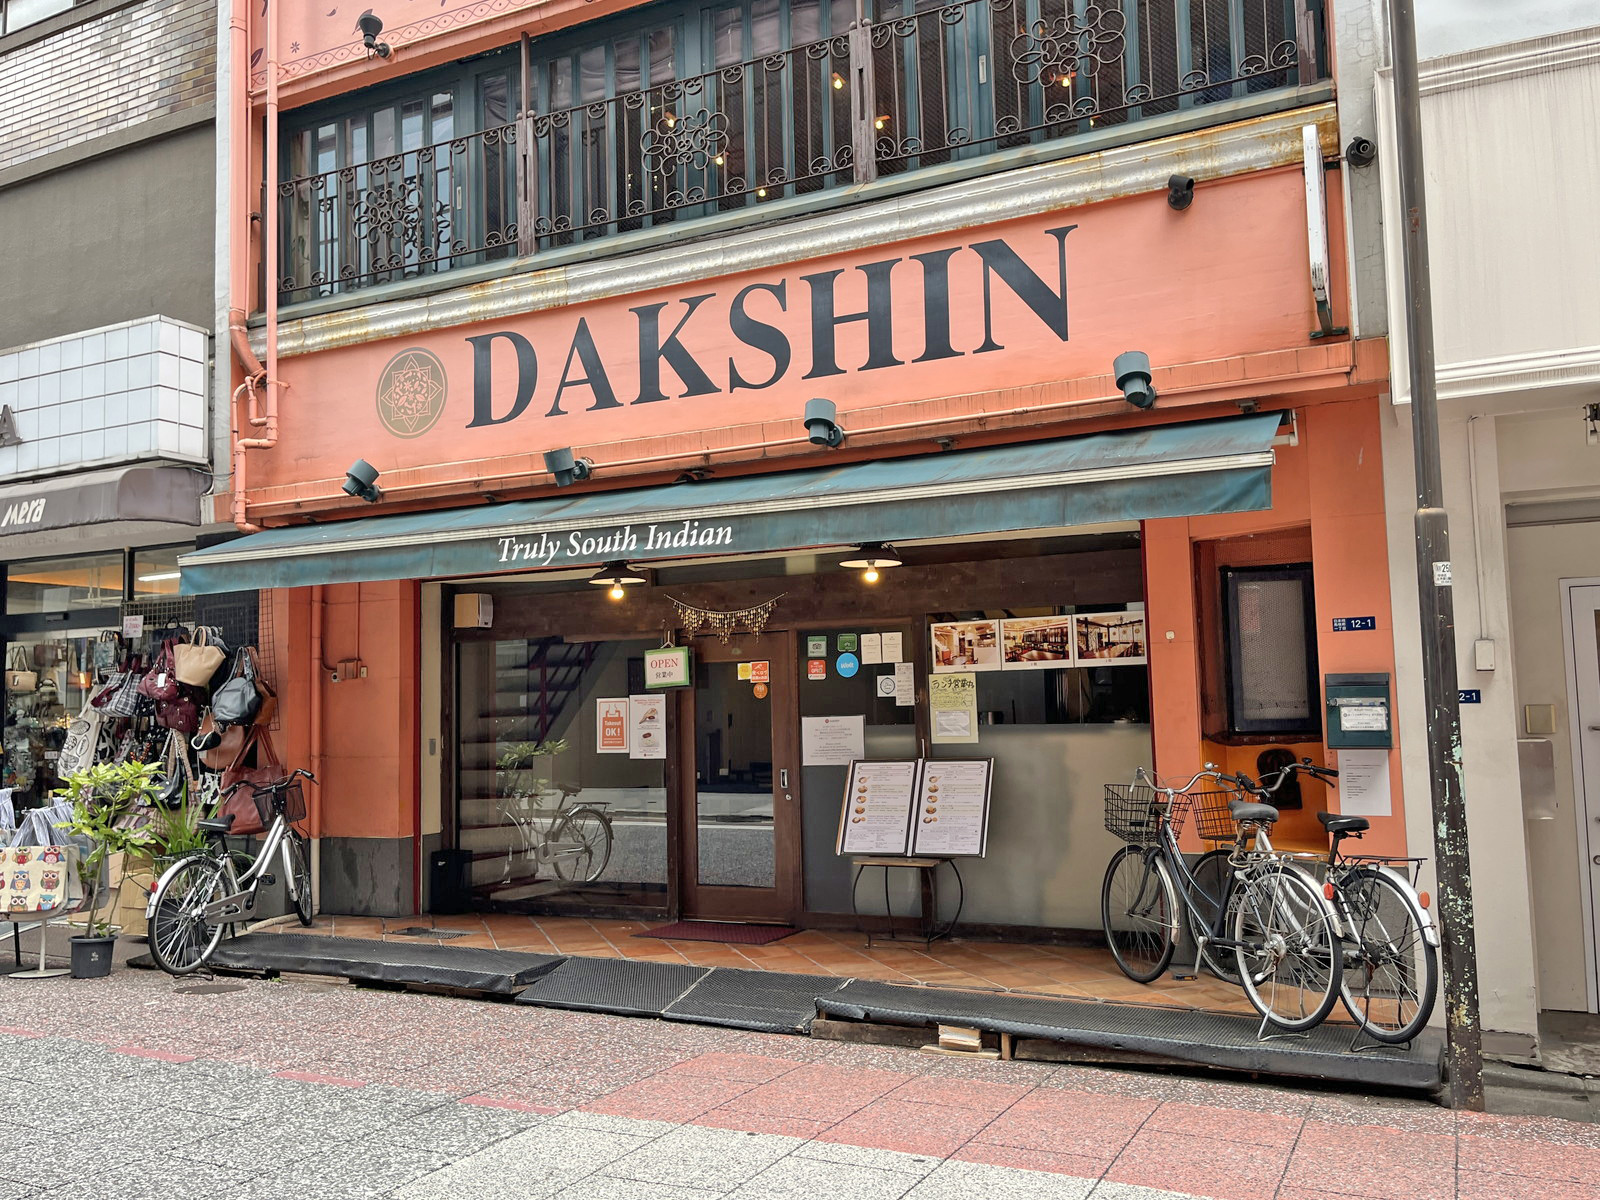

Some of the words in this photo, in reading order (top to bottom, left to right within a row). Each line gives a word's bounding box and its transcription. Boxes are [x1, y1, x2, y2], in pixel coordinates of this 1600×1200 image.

[465, 224, 1077, 428] DAKSHIN
[498, 533, 561, 566] Truly
[567, 525, 637, 557] South
[646, 520, 733, 550] Indian
[1350, 618, 1371, 628] 12-1
[650, 657, 679, 669] OPEN
[655, 671, 673, 679] 営業中
[605, 727, 621, 737] OK!
